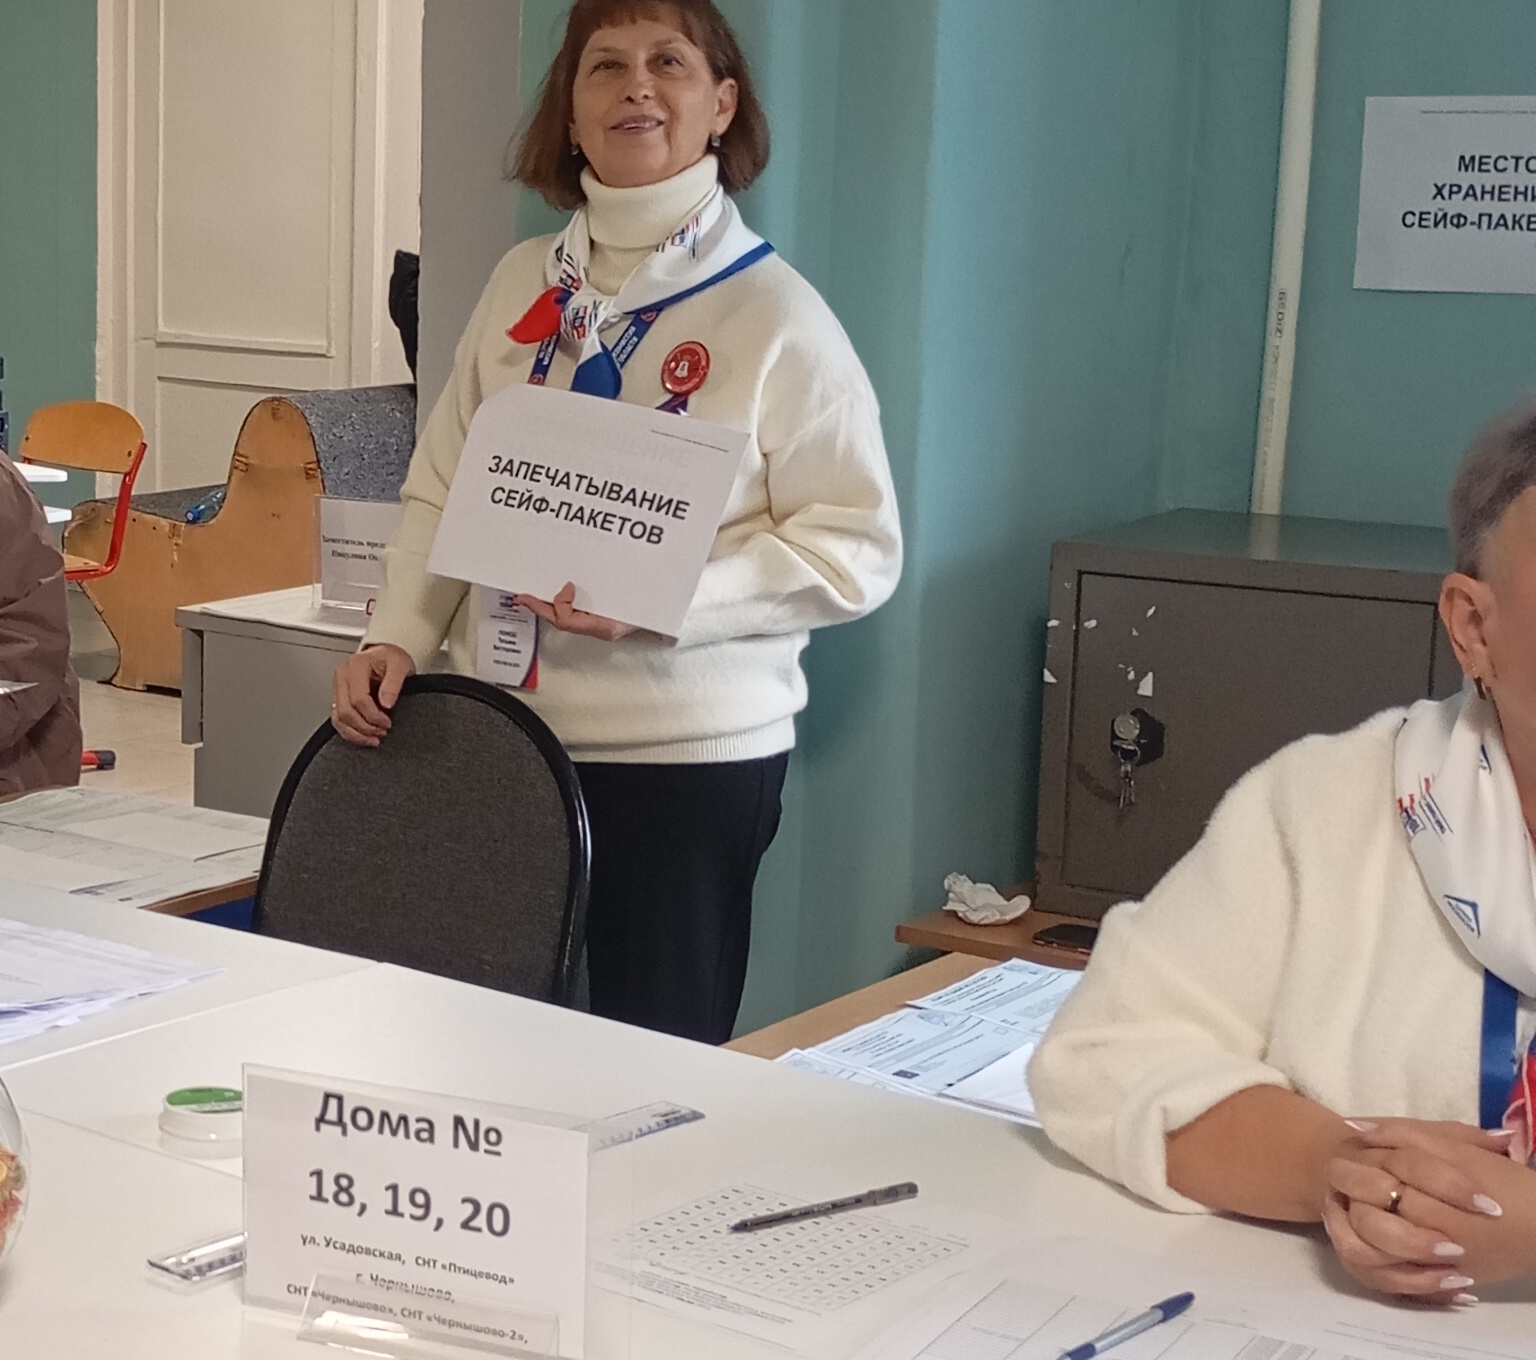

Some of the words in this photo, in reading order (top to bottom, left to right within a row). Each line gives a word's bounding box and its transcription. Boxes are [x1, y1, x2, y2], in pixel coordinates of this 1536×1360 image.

[1457, 154, 1536, 174] МЕСТО
[486, 454, 692, 522] ЗАПЕЧАТЫВАНИЕ
[489, 486, 666, 548] СЕЙФ-ПАКЕТОВ
[314, 1090, 436, 1145] Дома
[452, 1114, 504, 1158] №
[307, 1167, 369, 1217] 18,
[382, 1181, 446, 1232] 19,
[458, 1195, 513, 1238] 20
[301, 1233, 321, 1248] ул.
[323, 1235, 407, 1265] Усадовская,
[414, 1255, 439, 1270] СНТ
[441, 1260, 516, 1286] «Птицевод»
[286, 1283, 309, 1297] СНТ
[400, 1307, 424, 1322] СНТ
[426, 1311, 529, 1345] «Чернышово-2»,
